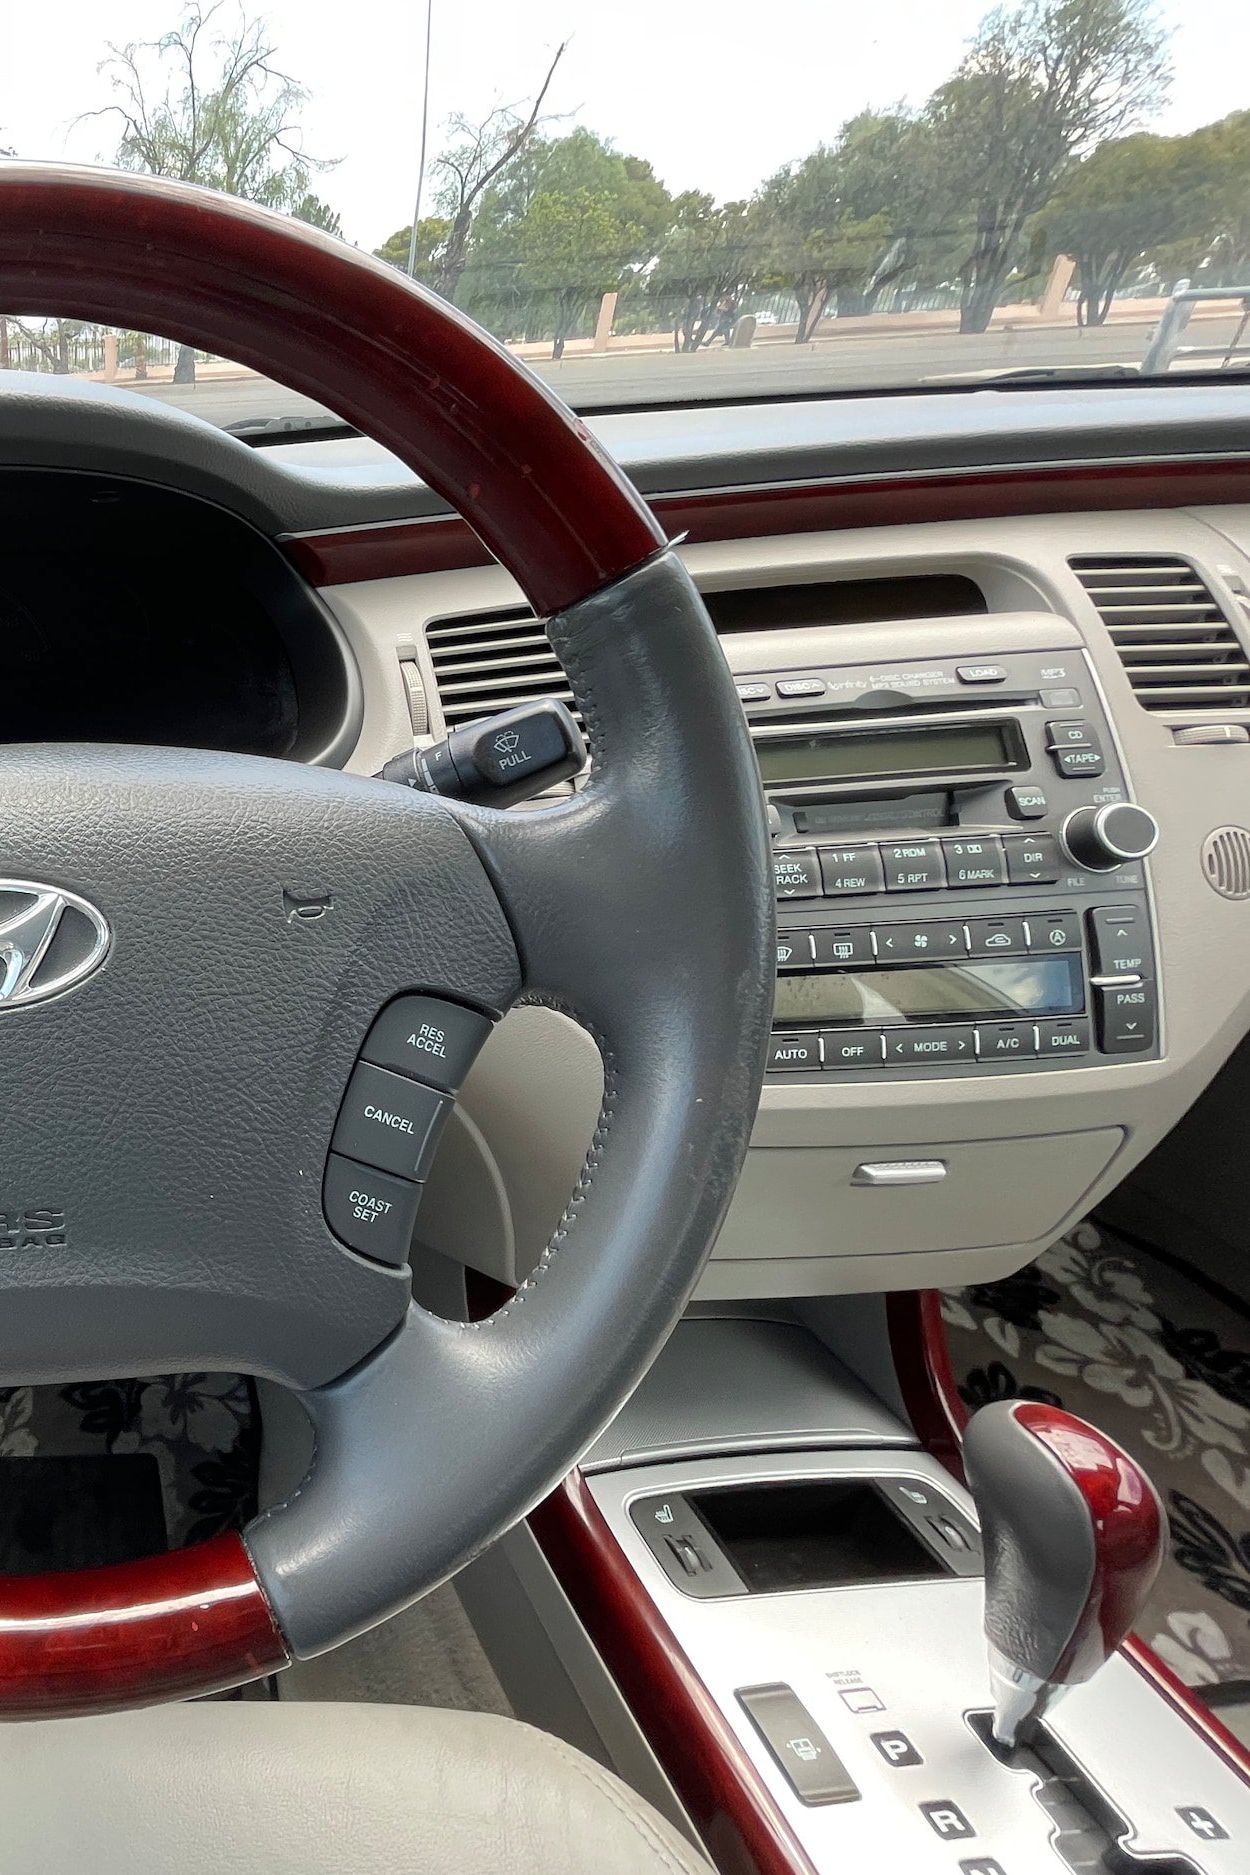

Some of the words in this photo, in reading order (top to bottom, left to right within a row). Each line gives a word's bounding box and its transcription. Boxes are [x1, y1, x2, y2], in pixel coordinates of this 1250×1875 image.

[969, 668, 998, 678] LOAD
[737, 687, 756, 695] ISC
[784, 683, 811, 691] DISC
[1068, 731, 1083, 740] CD
[434, 751, 442, 762] F
[498, 750, 532, 771] PULL
[1069, 753, 1095, 764] TAPE
[1018, 796, 1046, 807] SCAN
[1093, 793, 1121, 803] ENTER
[954, 844, 963, 854] 3
[832, 853, 839, 863] 1
[842, 852, 856, 862] FF
[1023, 852, 1043, 863] DIR
[776, 874, 809, 885] RACK
[897, 873, 905, 884] 5
[907, 873, 929, 883] RPT
[958, 869, 966, 880] 6
[966, 869, 996, 880] MARK
[1115, 874, 1139, 884] TUNE
[835, 878, 842, 889] 4
[843, 877, 866, 888] REW
[1067, 877, 1086, 887] FILE
[1113, 958, 1142, 969] TEMP
[1116, 993, 1145, 1005] PASS
[419, 1023, 445, 1042] RES
[997, 1038, 1020, 1049] A/C
[1051, 1034, 1081, 1046] DUAL
[406, 1033, 447, 1059] ACCEL
[841, 1046, 864, 1057] OFF
[913, 1041, 948, 1052] MODE
[774, 1049, 808, 1060] AUTO
[363, 1104, 415, 1135] CANCEL
[348, 1190, 393, 1215] COAST
[352, 1205, 379, 1224] SET
[880, 1739, 908, 1761] P
[929, 1809, 966, 1833] R
